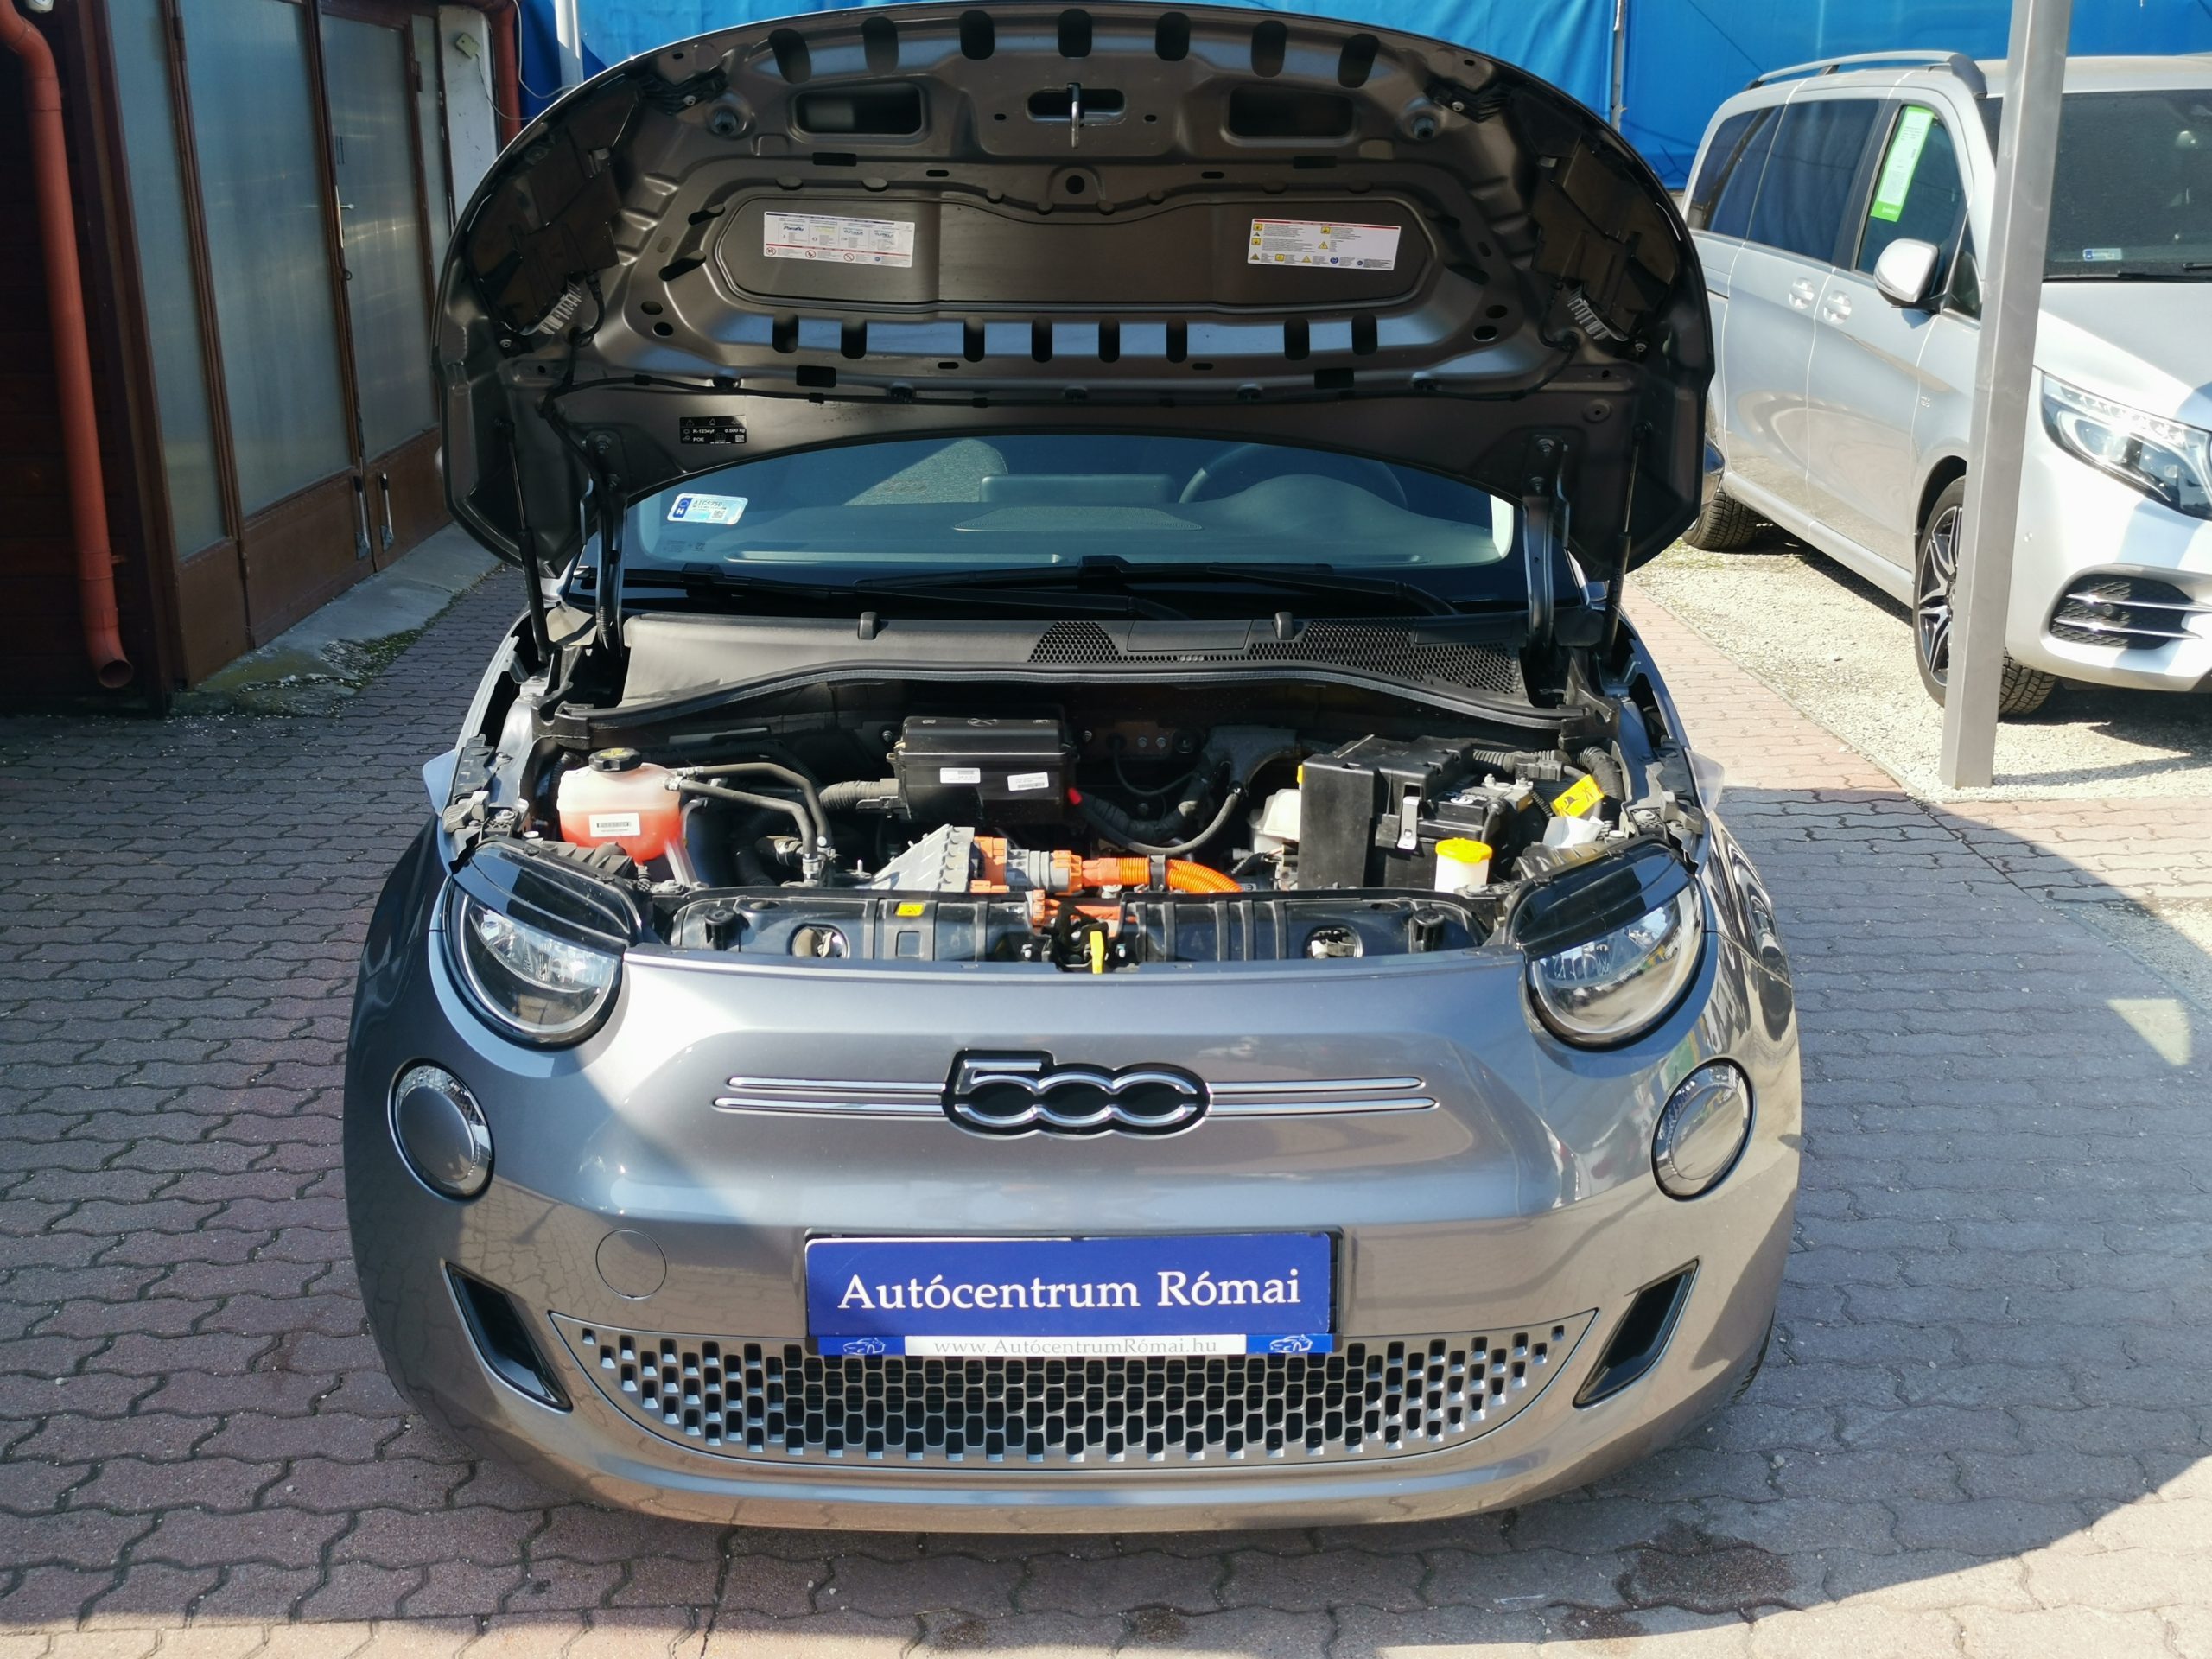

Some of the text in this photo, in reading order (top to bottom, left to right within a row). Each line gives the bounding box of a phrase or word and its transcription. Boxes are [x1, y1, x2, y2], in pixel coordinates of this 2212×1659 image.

[944, 1050, 1210, 1139] 500
[836, 1268, 1301, 1310] Autócentrum Római
[934, 1338, 1217, 1355] www.AutócentrumRómai.hu
